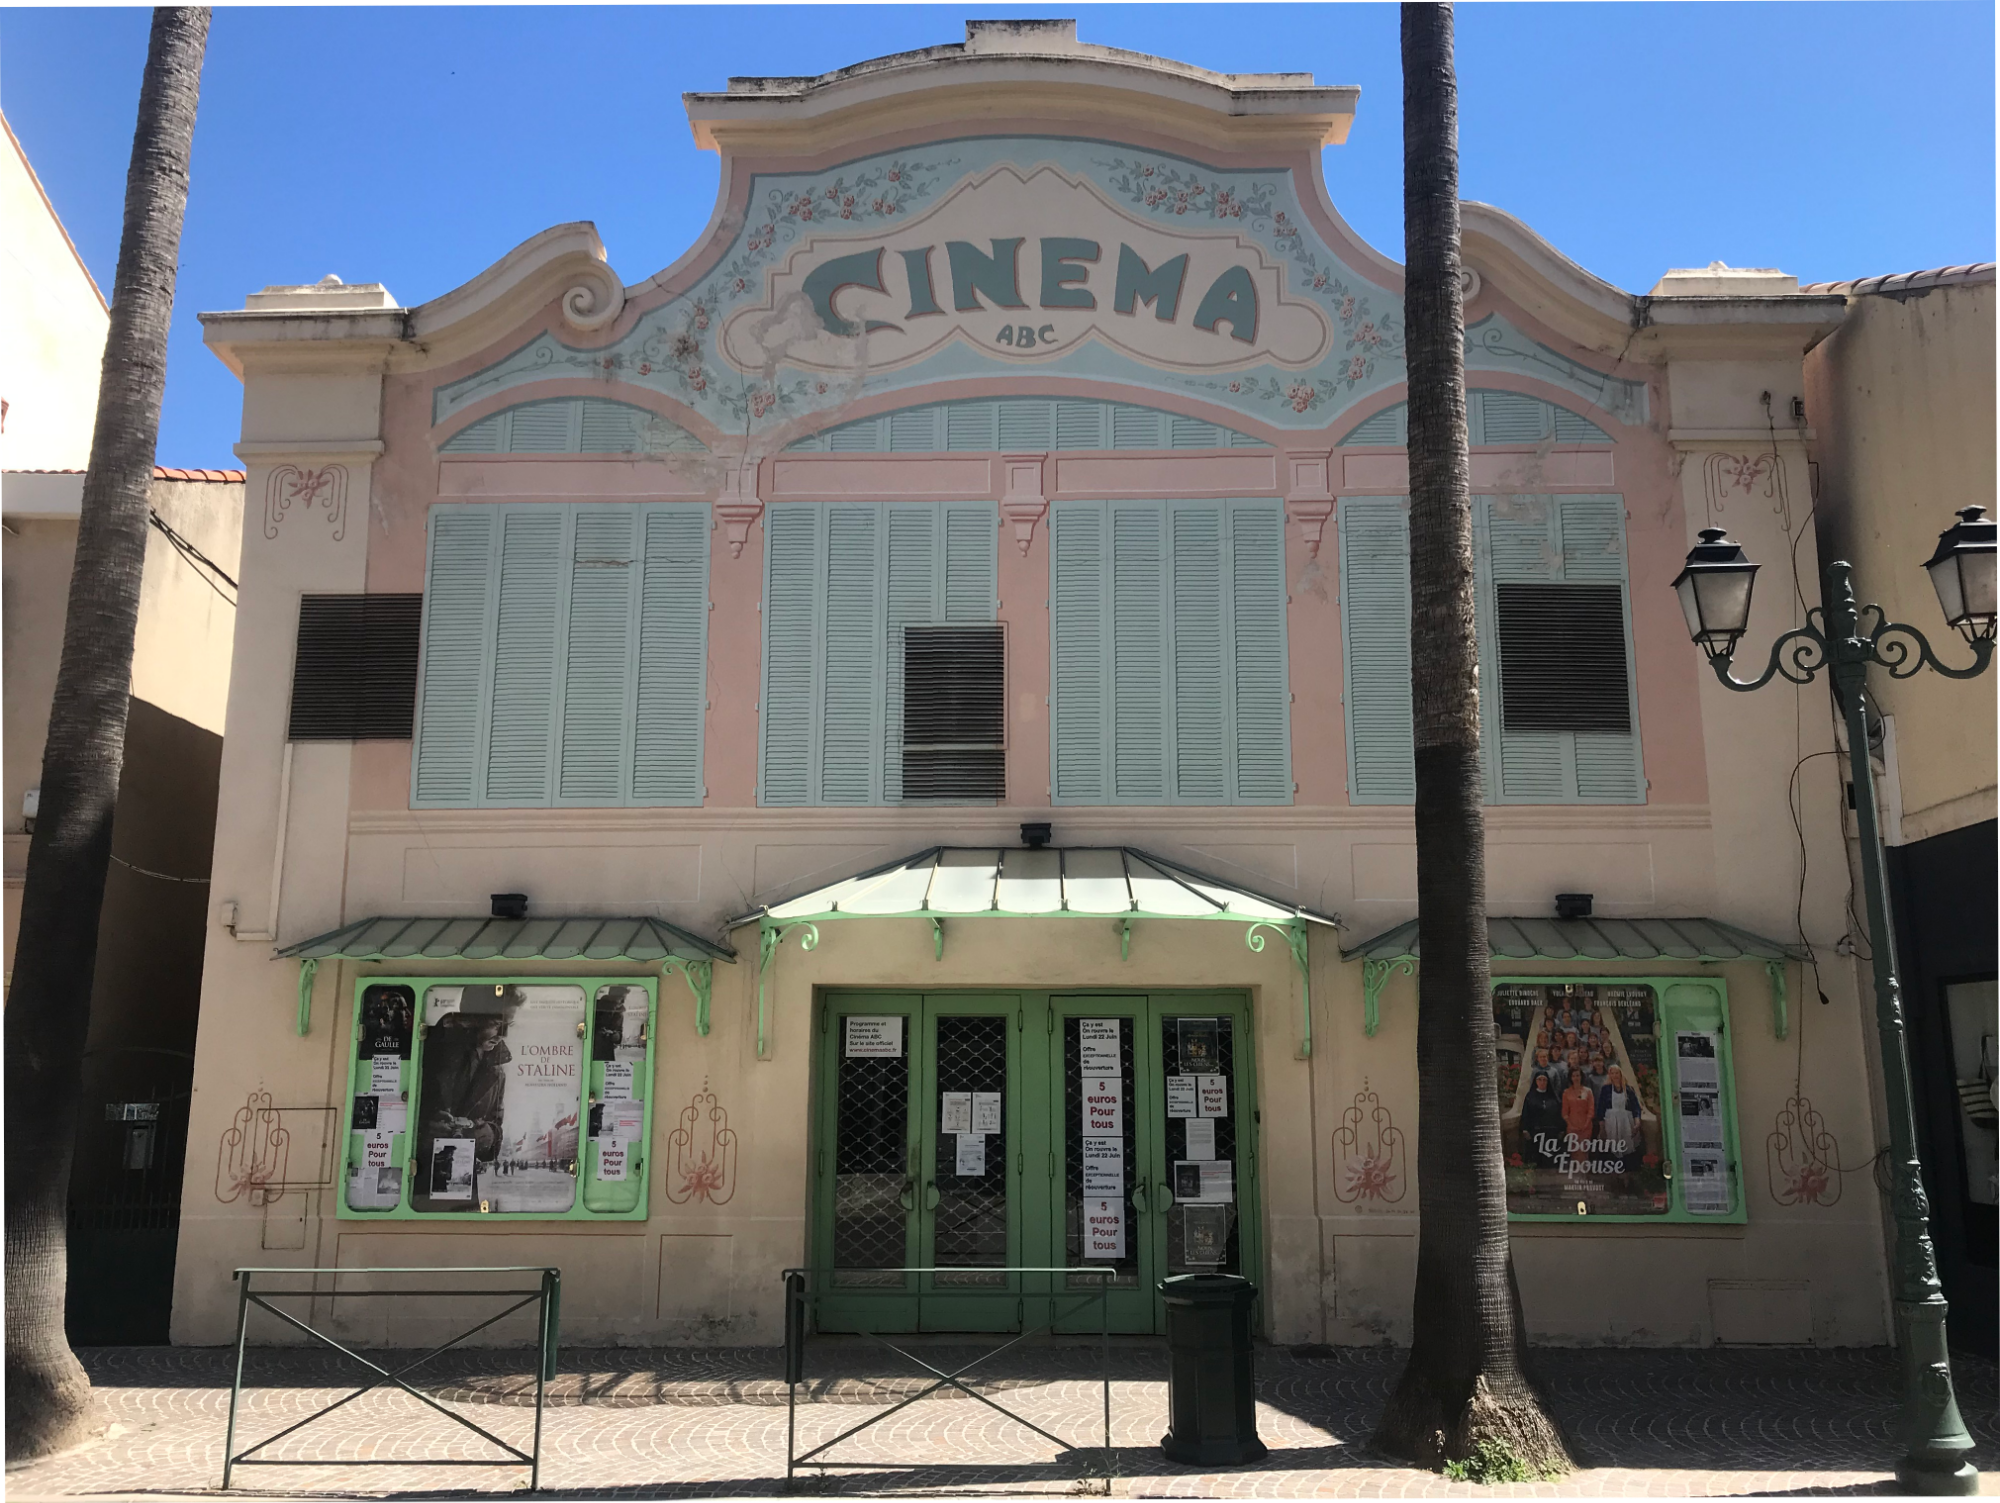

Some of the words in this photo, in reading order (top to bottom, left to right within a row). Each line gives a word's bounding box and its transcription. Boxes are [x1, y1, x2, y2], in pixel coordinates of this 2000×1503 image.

[801, 237, 1259, 347] CINEMA
[996, 324, 1058, 349] ABC
[521, 1045, 574, 1056] L'OMBRE
[517, 1064, 576, 1076] STALINE
[1099, 1081, 1106, 1091] 5
[1087, 1096, 1117, 1104] euros
[1090, 1106, 1116, 1116] Pour
[1091, 1119, 1114, 1129] tous
[1533, 1132, 1561, 1158] La
[1563, 1132, 1628, 1153] Bonne
[603, 1158, 622, 1166] Pour
[1101, 1201, 1107, 1211] 5
[1089, 1216, 1120, 1224] euros
[1092, 1227, 1118, 1237] Pour
[1093, 1241, 1117, 1250] tous
